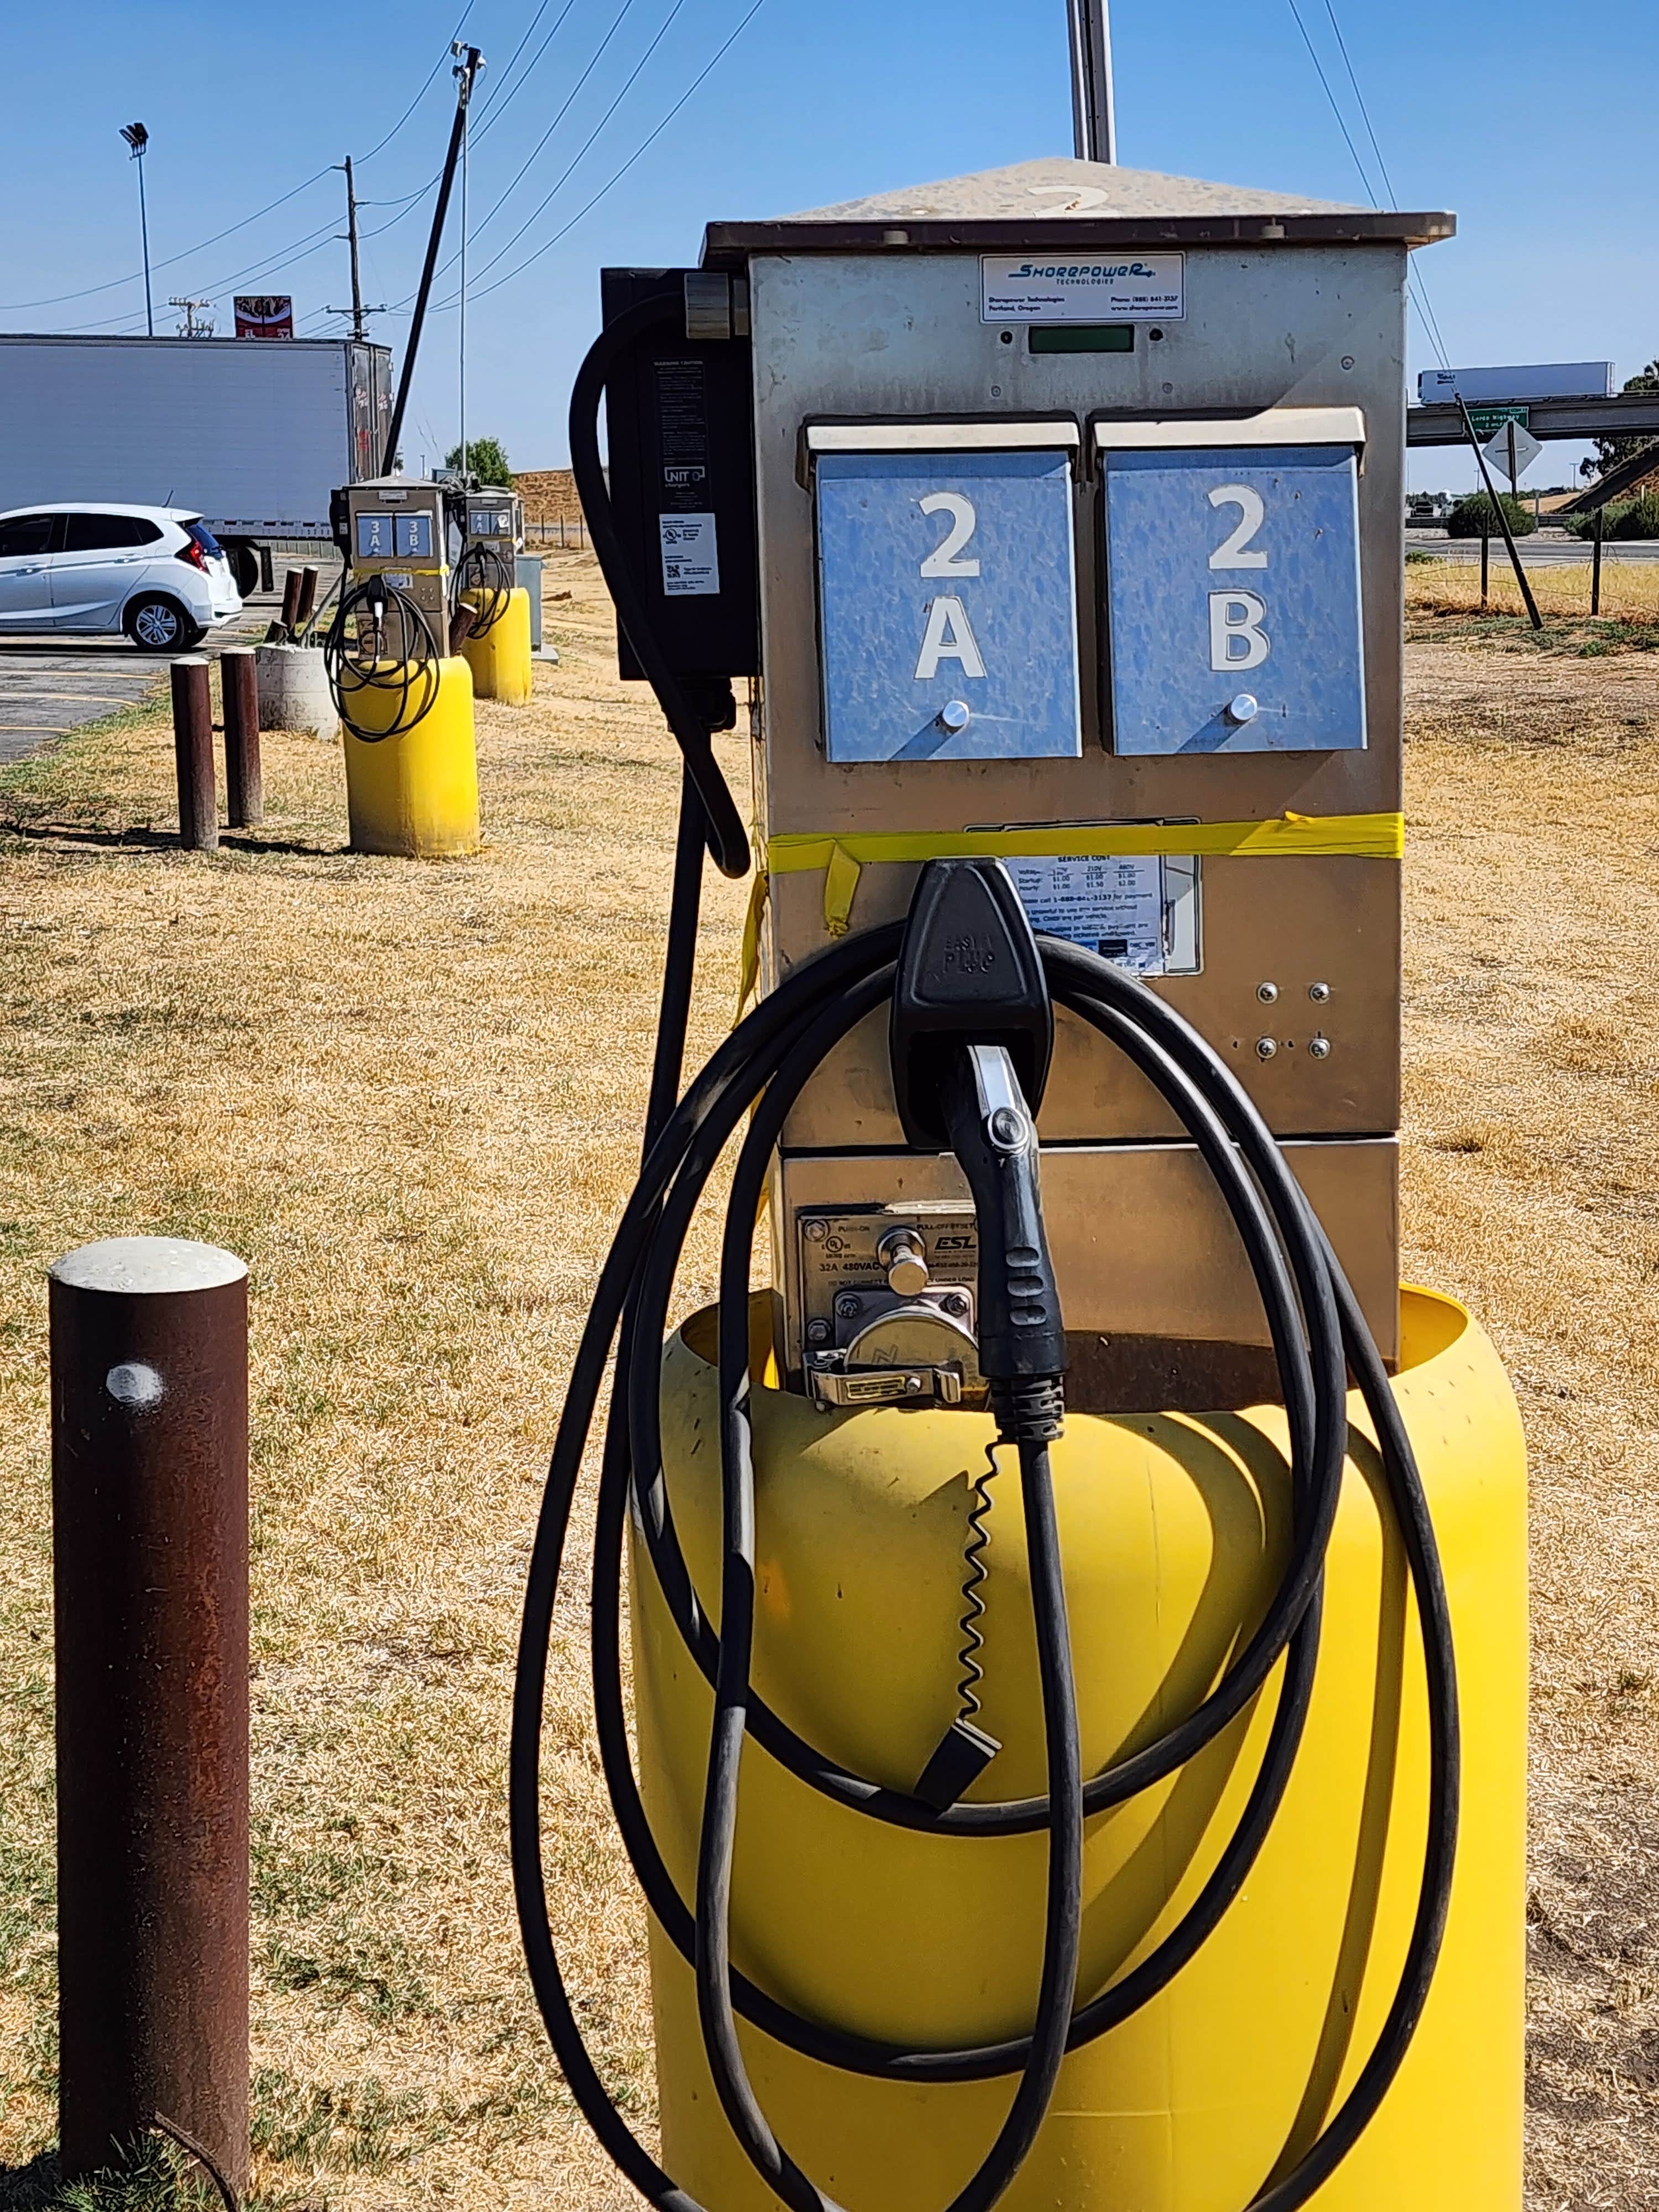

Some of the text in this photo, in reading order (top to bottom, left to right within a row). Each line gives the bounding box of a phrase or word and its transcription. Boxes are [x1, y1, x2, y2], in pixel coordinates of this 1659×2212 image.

[1008, 263, 1152, 278] SHOREPOWER
[371, 520, 380, 534] 3
[409, 520, 418, 534] 3
[1206, 483, 1269, 571] 2
[370, 535, 380, 547] A
[409, 535, 419, 546] B
[919, 491, 980, 578] 2
[914, 595, 987, 680] A
[1207, 589, 1270, 672] B
[935, 1236, 977, 1250] ESL
